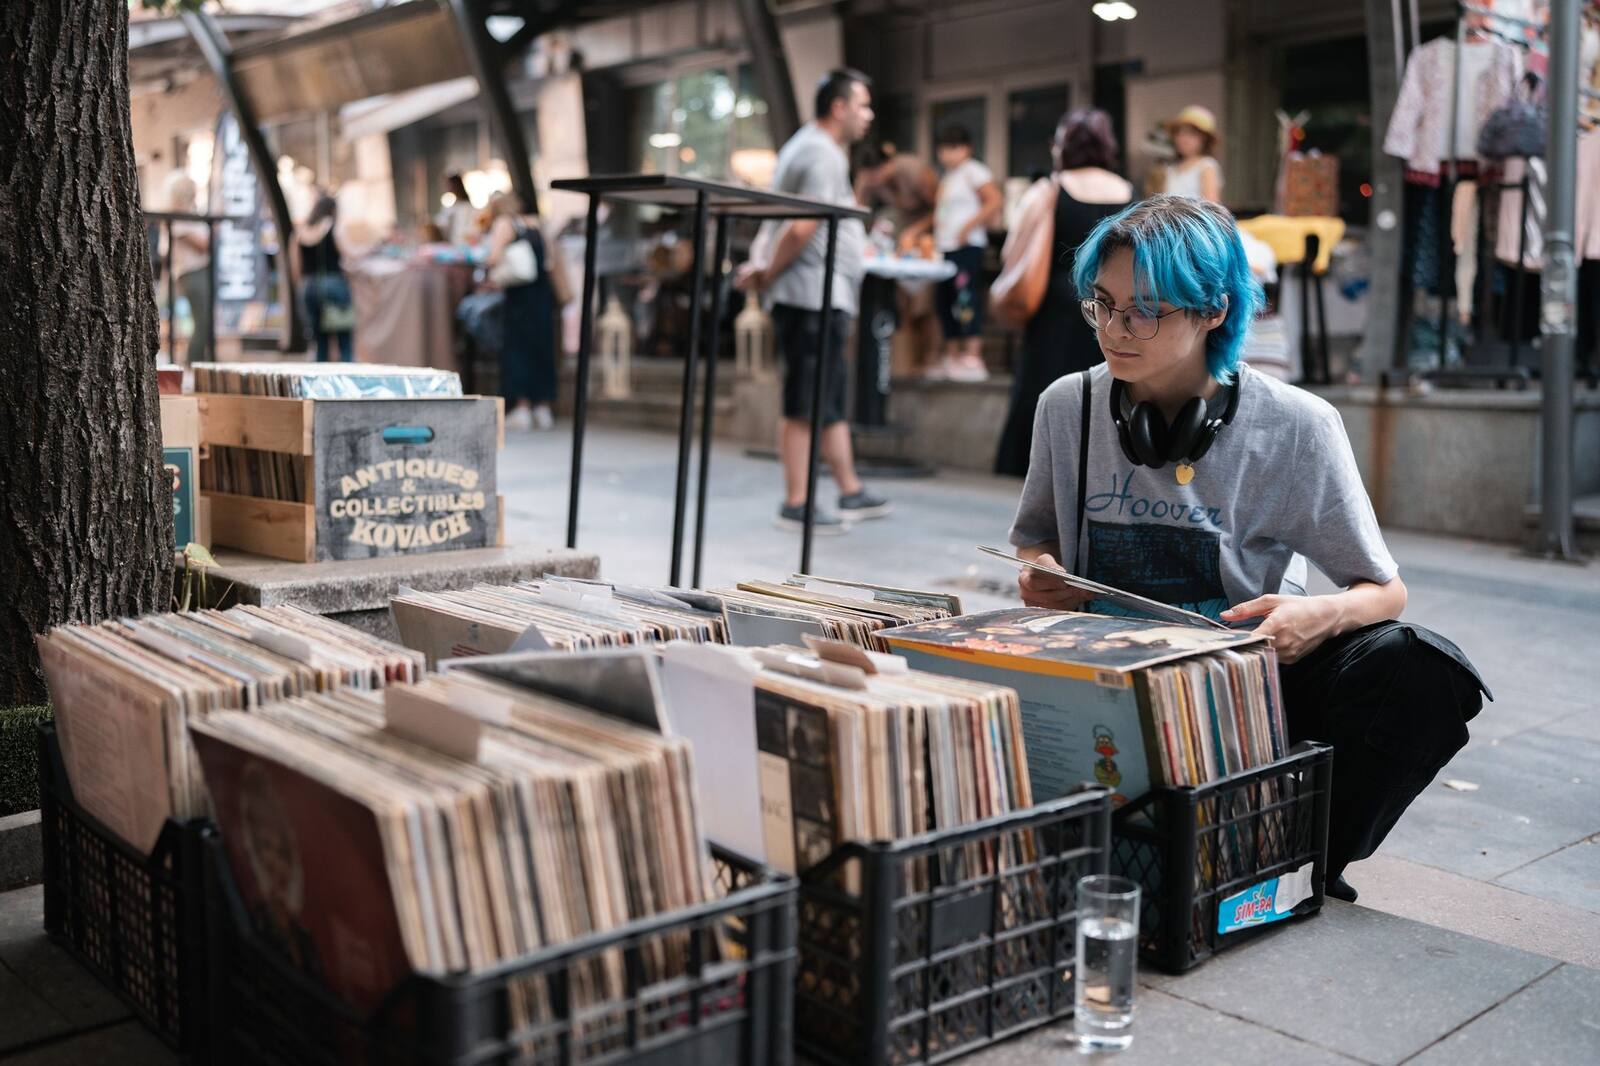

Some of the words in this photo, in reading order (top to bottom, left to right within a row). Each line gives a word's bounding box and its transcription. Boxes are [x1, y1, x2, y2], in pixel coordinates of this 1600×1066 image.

[340, 458, 479, 497] ANTIQUES
[401, 478, 416, 493] &
[330, 491, 485, 518] COLLECTIBLES
[1084, 468, 1223, 526] Hoover
[349, 511, 471, 549] KOVACH
